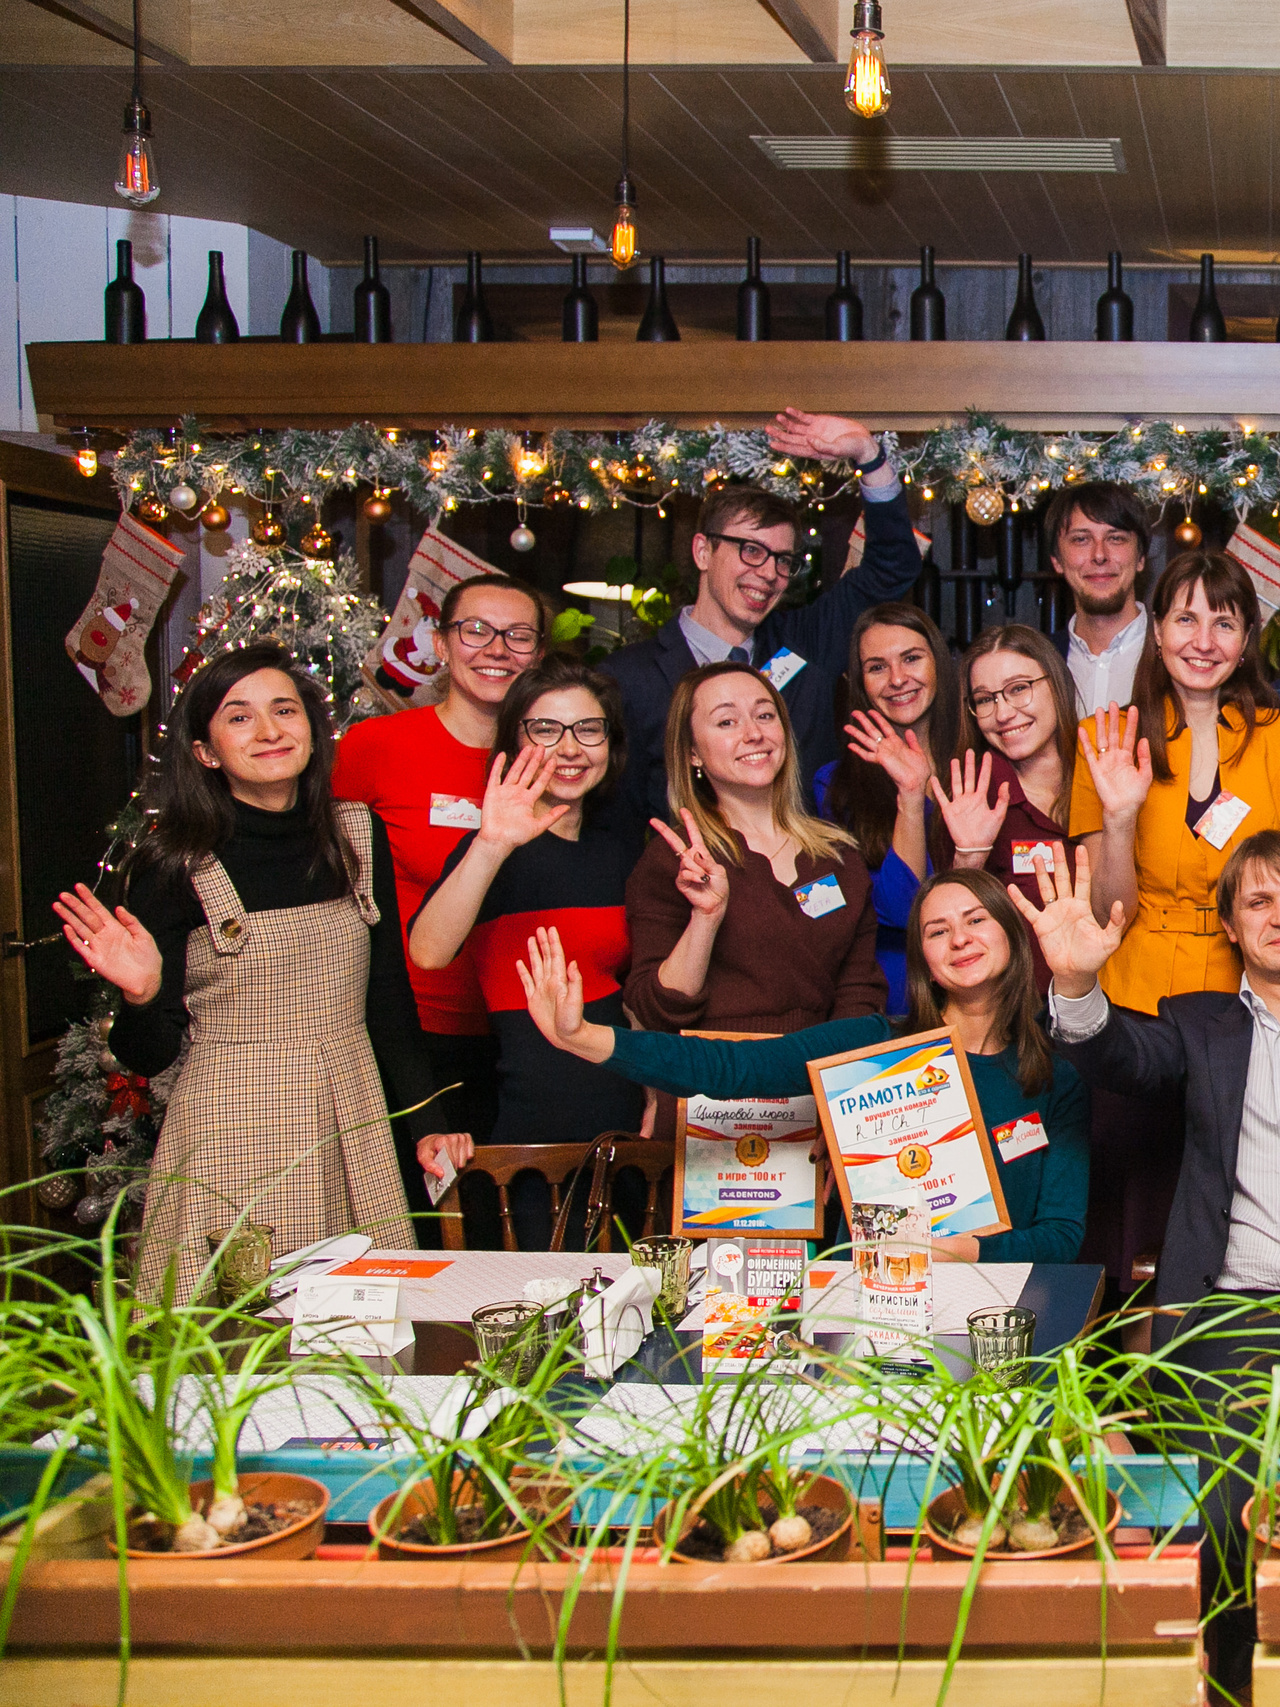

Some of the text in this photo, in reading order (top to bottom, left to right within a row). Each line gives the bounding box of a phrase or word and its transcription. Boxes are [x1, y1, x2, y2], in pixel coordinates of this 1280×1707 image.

[840, 1081, 917, 1115] ГРАМОТА
[865, 1098, 938, 1122] вручается команде
[733, 1123, 773, 1131] занявшей
[889, 1128, 928, 1145] занявшей
[749, 1139, 756, 1153] 1
[908, 1149, 918, 1165] 2
[726, 1173, 747, 1182] игре
[736, 1191, 776, 1199] DENTONS
[930, 1196, 951, 1208] TONS
[747, 1259, 803, 1270] ФИРМЕННЫЕ
[747, 1271, 801, 1288] БУРГЕРЫ
[757, 1298, 765, 1306] ОТ
[869, 1294, 919, 1307] ИГРИСТЫЙ
[868, 1329, 900, 1340] СКИДКА
